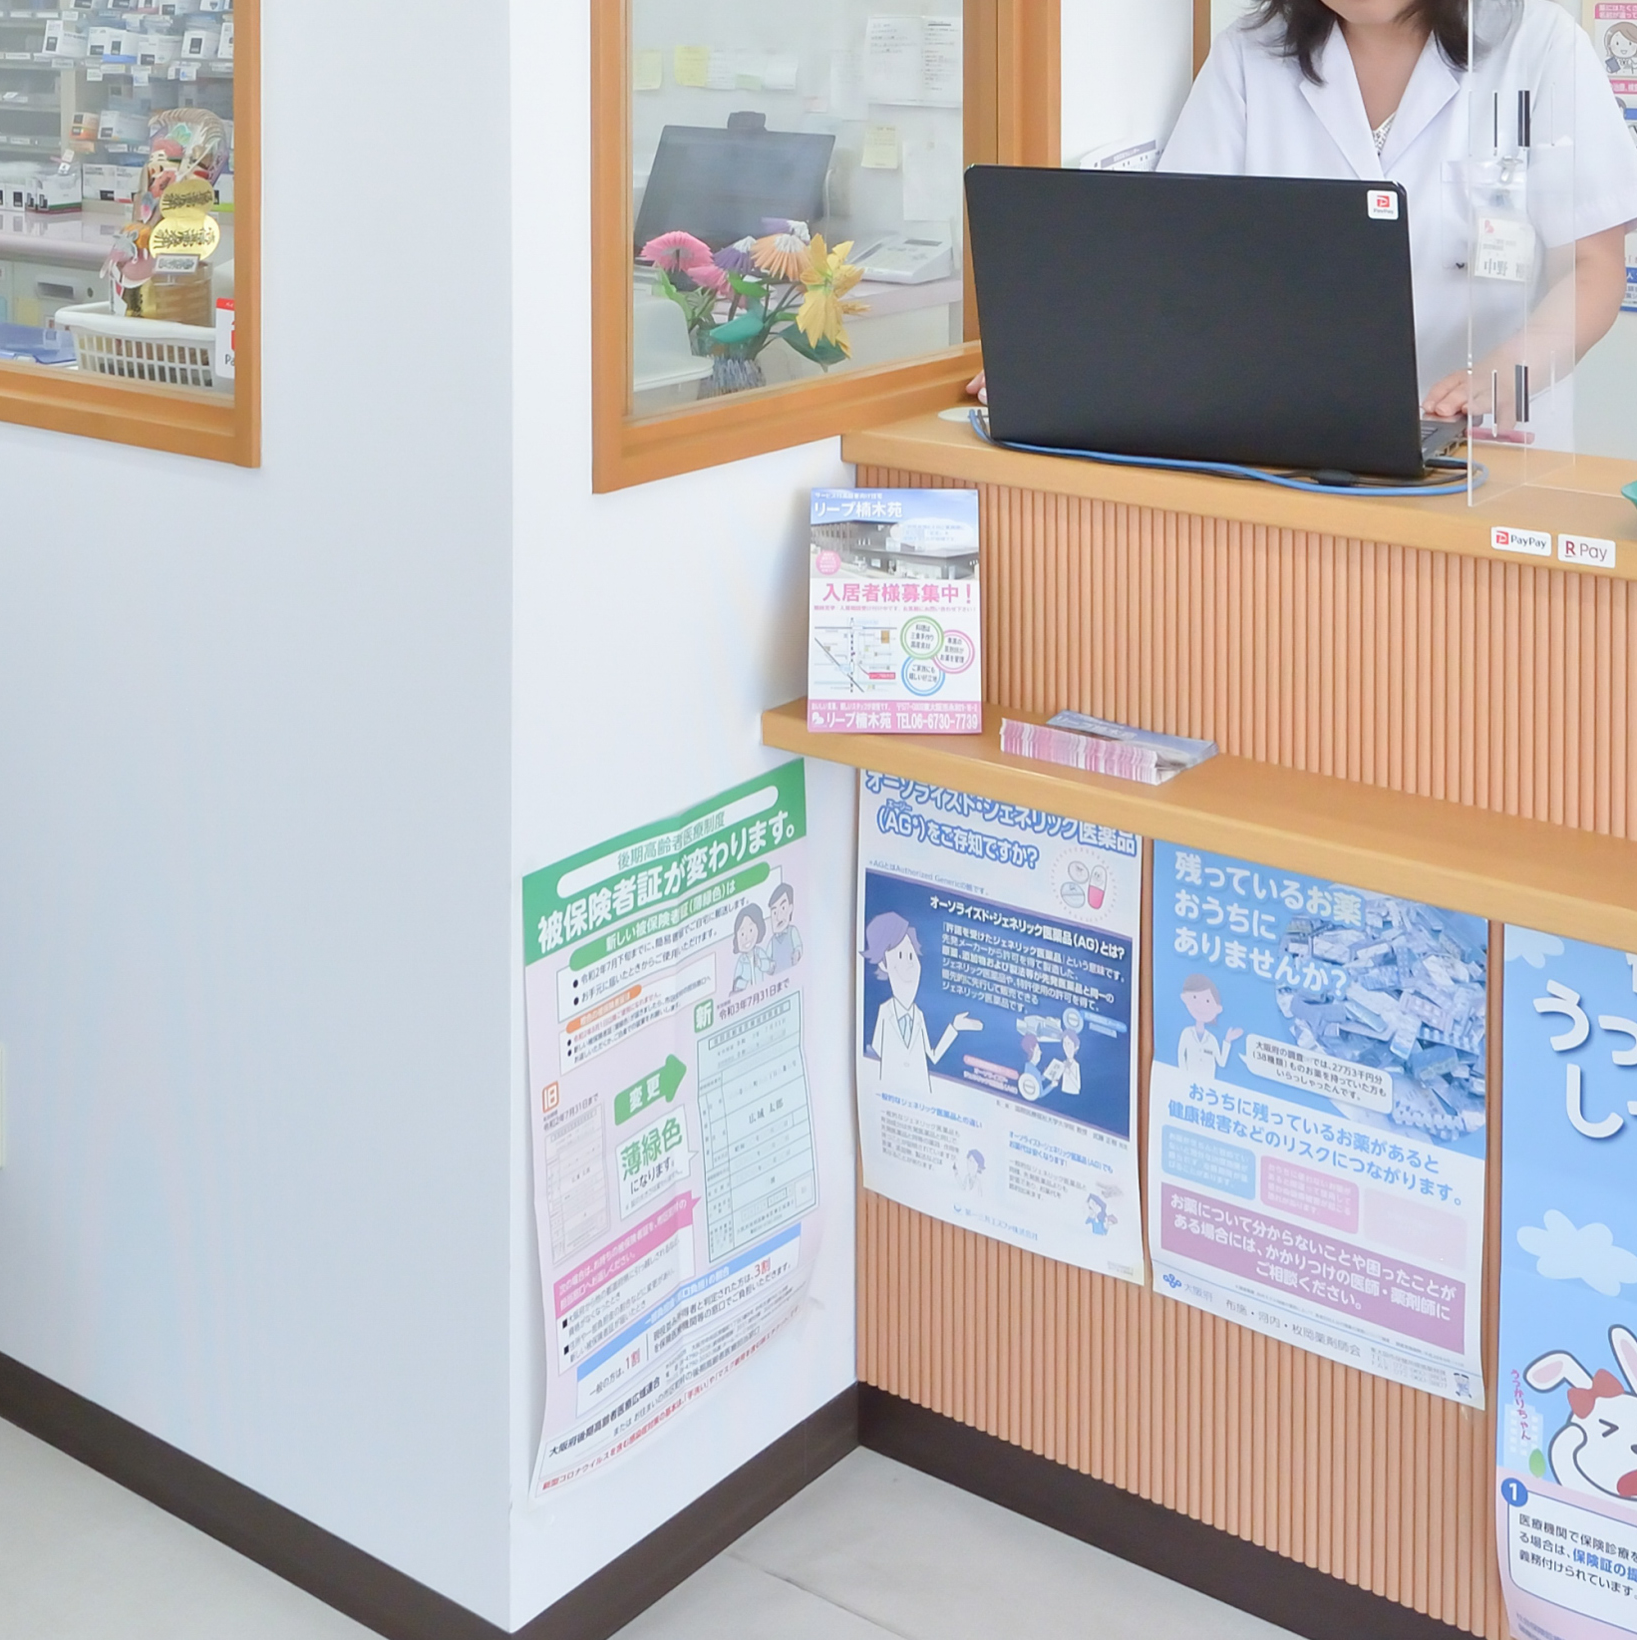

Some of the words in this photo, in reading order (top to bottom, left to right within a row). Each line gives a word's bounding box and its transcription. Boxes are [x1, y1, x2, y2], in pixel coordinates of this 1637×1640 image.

[1511, 535, 1546, 549] PayPay
[1580, 543, 1607, 562] Pay
[823, 583, 971, 604] 入居者様募集中！
[618, 811, 725, 871] 後期高齢者医療制度
[538, 809, 795, 954] 被保険者証が変わります。
[1174, 851, 1363, 927] 残っているお薬
[1174, 890, 1277, 940] おうちに
[1174, 928, 1348, 996] ありませんか？
[696, 1002, 712, 1029] 新
[719, 978, 790, 1021] 令和3年7月31日まで
[544, 1086, 558, 1108] 旧
[629, 1072, 661, 1113] 変更
[620, 1116, 683, 1181] 薄緑色
[1168, 1099, 1462, 1206] 健康被害などのリスクにつながります。
[1188, 1083, 1440, 1175] おうちに残っているお薬があると
[630, 1157, 676, 1195] になります。
[1171, 1194, 1456, 1301] お薬について分からないことや困ったことが
[1174, 1214, 1451, 1321] ある場合には、かかりつけの医師・薬剤師に
[1256, 1261, 1363, 1311] ご相談ください。
[1510, 1368, 1533, 1442] うっかりちゃん
[1508, 1484, 1521, 1503] 1
